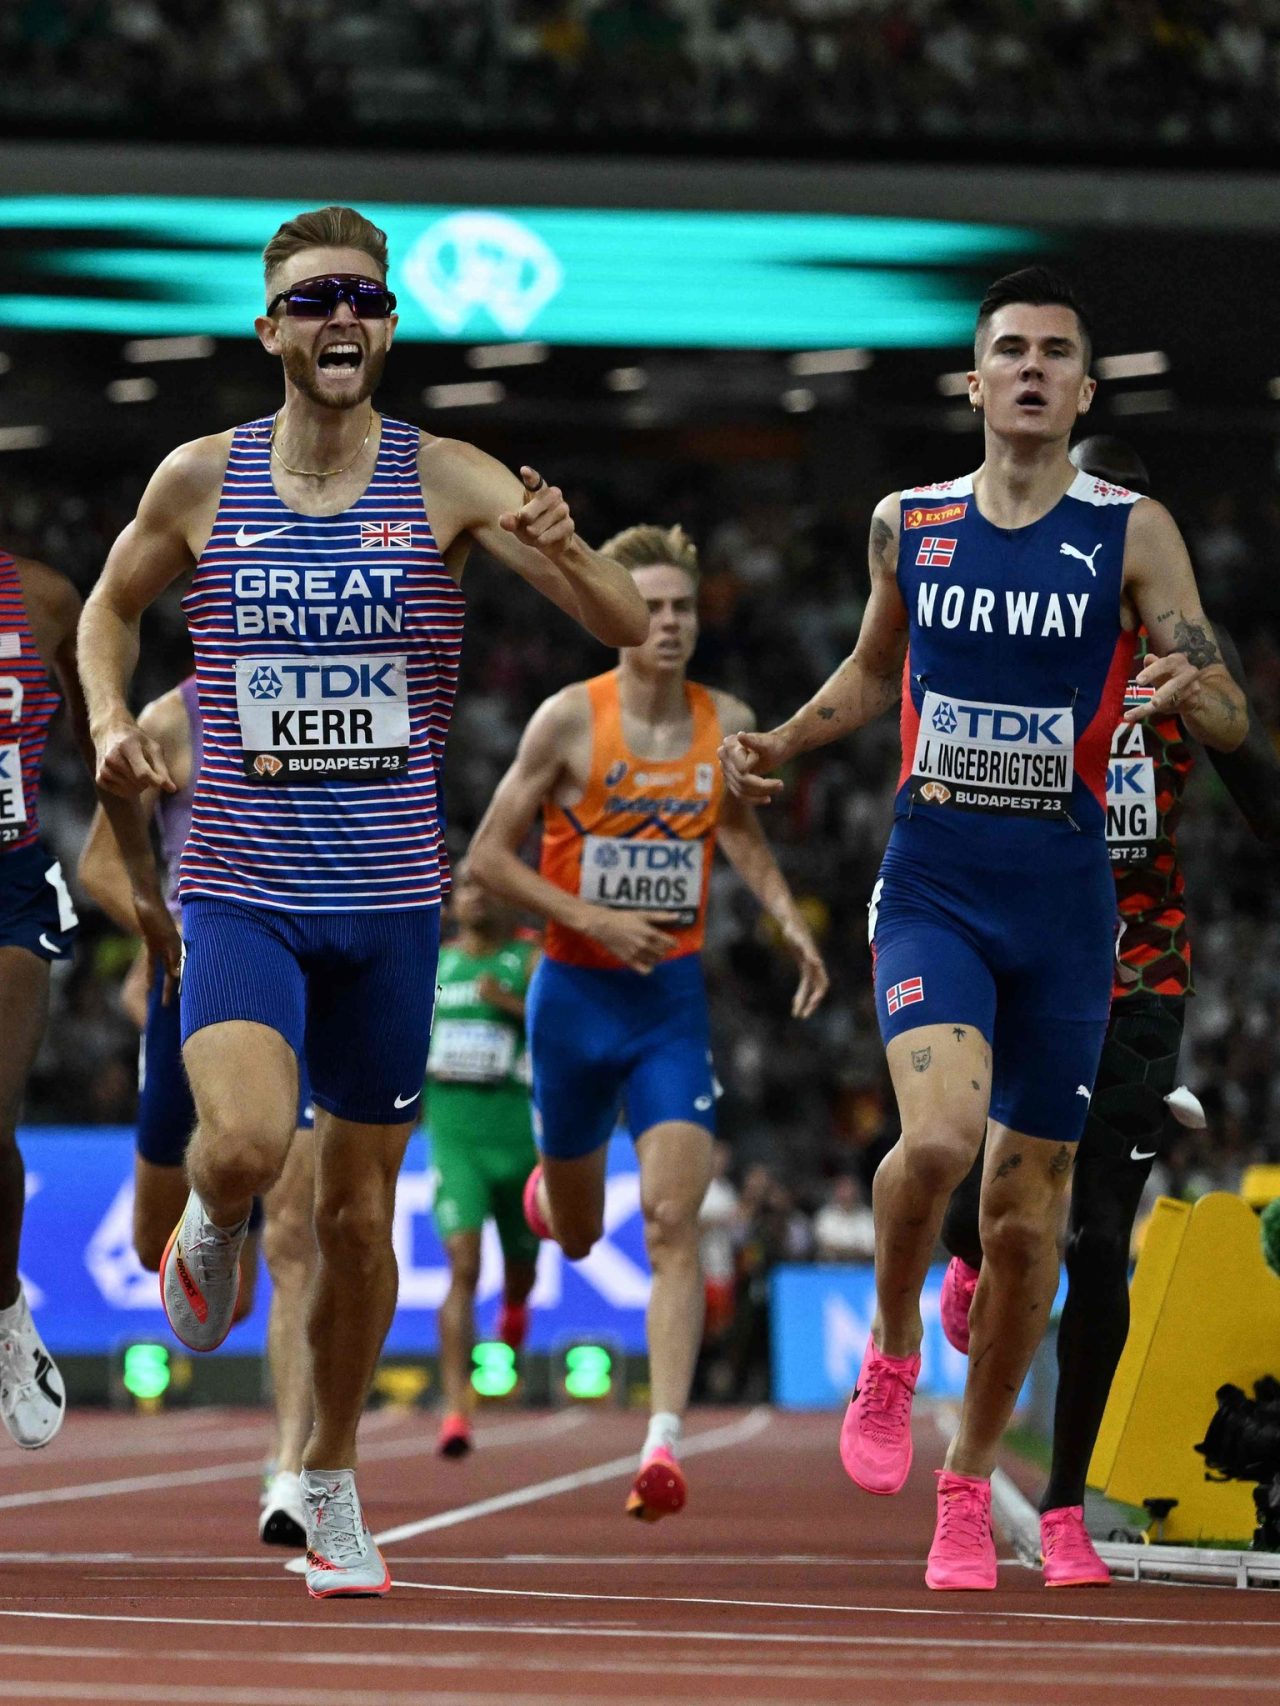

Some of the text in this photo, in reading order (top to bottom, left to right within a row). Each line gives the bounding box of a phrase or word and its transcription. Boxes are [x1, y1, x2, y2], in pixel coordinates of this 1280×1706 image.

[926, 506, 961, 521] EXTRA
[234, 568, 403, 599] GREAT
[235, 605, 402, 635] BRITAIN
[918, 582, 1089, 638] NORWAY
[282, 664, 397, 698] TDK
[272, 709, 374, 746] KERR
[958, 706, 1063, 745] TDK
[289, 755, 400, 771] BUDAPEST 23
[938, 745, 1067, 788] INGEBRIGTSEN
[955, 791, 1061, 811] BUDAPEST 23
[620, 844, 695, 870] TDK
[598, 873, 688, 903] LAROS
[176, 1258, 198, 1297] BROOKS
